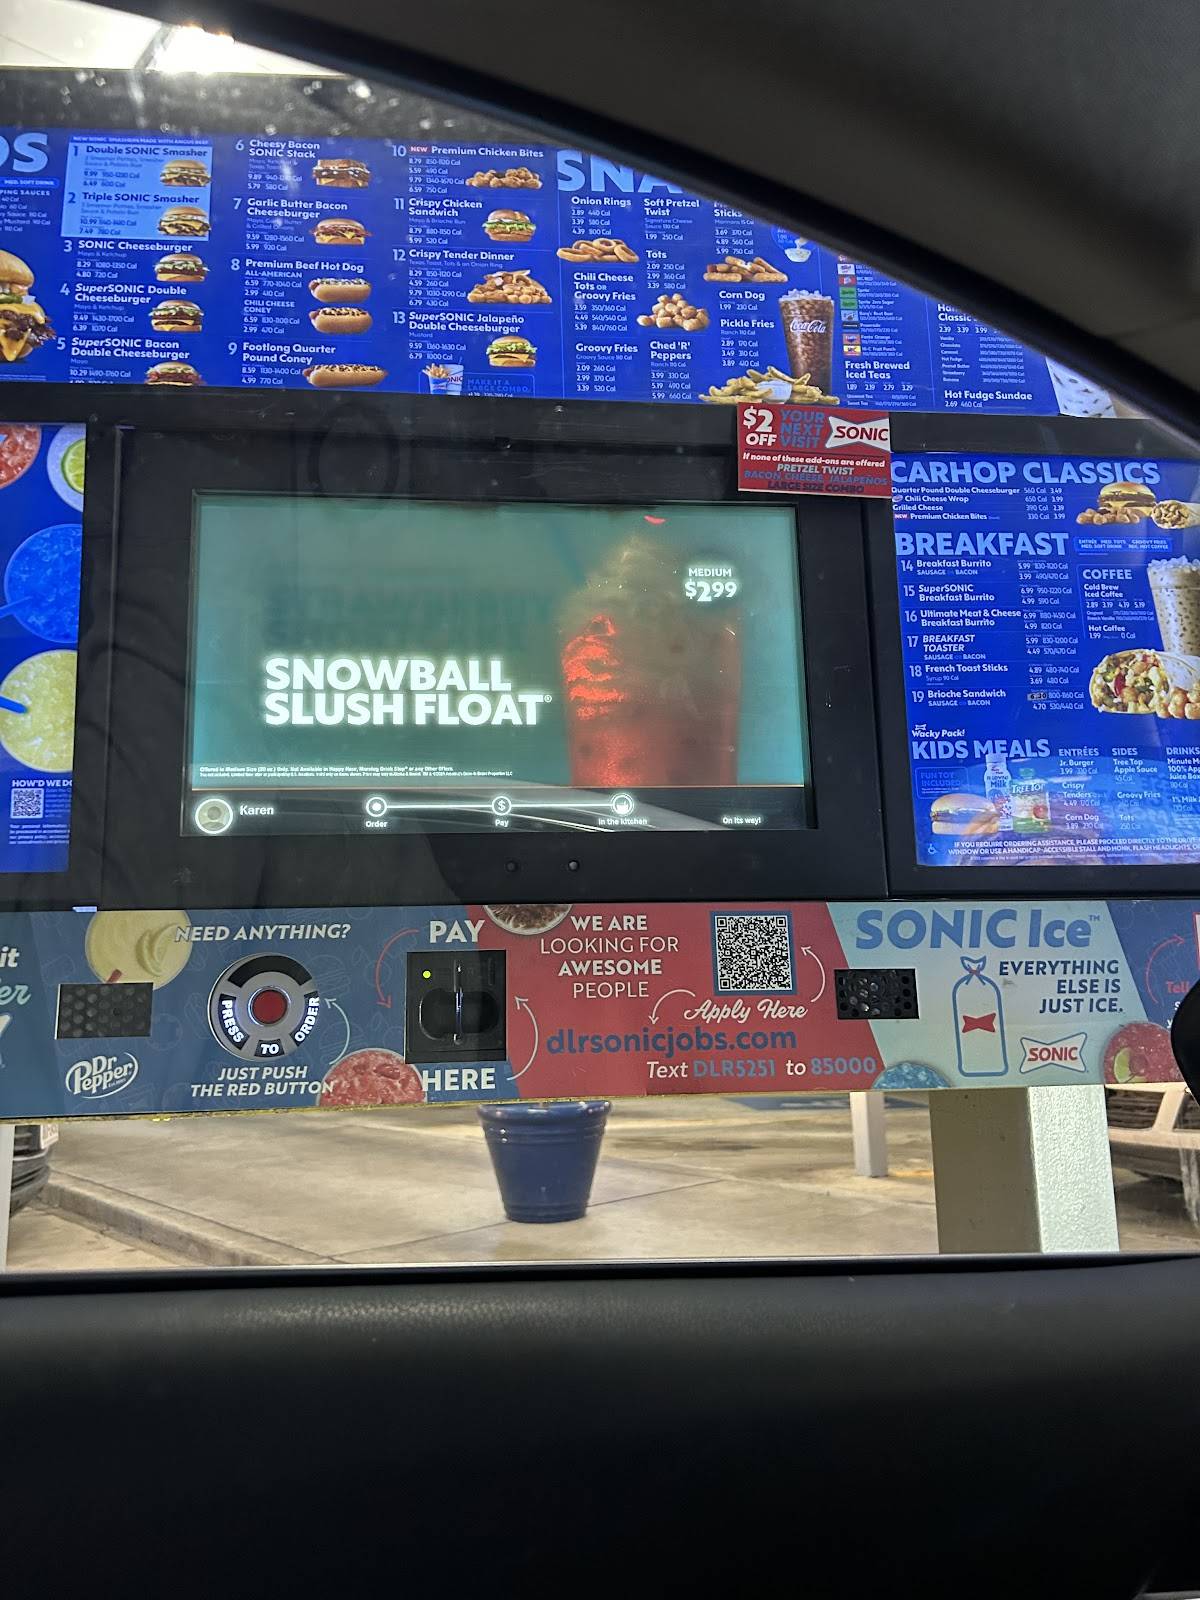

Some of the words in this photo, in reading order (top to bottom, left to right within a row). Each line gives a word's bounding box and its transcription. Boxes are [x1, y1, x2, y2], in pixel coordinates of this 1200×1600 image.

[73, 146, 78, 156] 1
[86, 146, 123, 154] Double
[125, 147, 161, 155] SONIC
[163, 148, 207, 156] Smasher
[235, 140, 244, 150] 6
[250, 140, 286, 149] Cheesy
[288, 141, 320, 149] Bacon
[392, 146, 406, 156] 10
[431, 147, 476, 155] Premium
[478, 148, 517, 156] Chicken
[520, 149, 543, 157] Bites
[0, 132, 48, 172] S
[288, 150, 315, 158] Stack
[572, 197, 602, 205] Onion
[604, 198, 631, 207] Rings
[644, 208, 670, 216] Twist
[64, 241, 72, 252] 3
[79, 241, 114, 249] SONIC
[118, 242, 192, 253] Cheeseburger
[393, 250, 406, 261] 12
[409, 250, 440, 261] Crispy
[443, 251, 478, 259] Tender
[480, 252, 514, 260] Dinner
[231, 259, 240, 270] 8
[246, 259, 293, 269] Premium
[296, 261, 319, 269] Beef
[321, 262, 340, 270] Hot
[343, 263, 363, 273] Dog
[745, 291, 765, 301] Dog
[752, 320, 774, 328] Fries
[576, 343, 612, 354] Groovy
[614, 344, 638, 352] Fries
[650, 341, 675, 349] Ched
[678, 341, 690, 349] 'R'
[651, 351, 691, 361] Peppers
[845, 361, 871, 369] Fresh
[868, 371, 891, 379] Teas
[944, 390, 962, 398] Hot
[964, 391, 994, 401] Fudge
[996, 392, 1032, 400] Sundae
[743, 406, 774, 432] $2
[781, 409, 825, 423] YOUR
[781, 423, 825, 434] NEXT
[834, 426, 888, 441] SONIC
[746, 433, 777, 446] OFF
[781, 435, 821, 448] VISIT
[777, 464, 820, 473] PRETZEL
[822, 466, 854, 475] TWIST
[855, 459, 885, 467] offered
[744, 471, 782, 480] BACON
[784, 473, 823, 482] CHEESE
[891, 461, 1016, 483] CARHOP
[1023, 462, 1161, 484] CLASSICS
[895, 532, 1069, 555] BREAKFAST
[901, 560, 913, 571] 14
[961, 560, 991, 568] Burrito
[688, 568, 731, 577] MEDIUM
[1082, 570, 1132, 579] COFFEE
[265, 658, 512, 691] SNOWBALL
[910, 665, 922, 677] 18
[982, 664, 1008, 672] Sticks
[912, 691, 924, 702] 19
[928, 690, 961, 698] Brioche
[963, 690, 1006, 698] Sandwich
[265, 693, 399, 725] SLUSH
[912, 730, 940, 739] Wacky
[942, 729, 965, 737] Pack!
[912, 741, 968, 759] KIDS
[974, 739, 1050, 758] MEALS
[1059, 746, 1099, 756] ENTRÉES
[1166, 747, 1200, 755] DRINKS
[240, 805, 274, 815] Karen
[745, 817, 761, 825] way!
[570, 916, 603, 931] WE
[608, 915, 648, 931] ARE
[855, 909, 1017, 949] SONIC
[175, 926, 230, 942] NEED
[234, 924, 351, 941] ANYTHING?
[429, 920, 485, 943] PAY
[540, 938, 633, 954] LOOKING
[640, 937, 679, 952] FOR
[558, 959, 662, 977] AWESOME
[999, 960, 1119, 976] EVERYTHING
[573, 982, 649, 998] PEOPLE
[1057, 980, 1099, 994] ELSE
[1104, 979, 1121, 993] IS
[684, 1000, 751, 1023] Apply
[757, 999, 809, 1019] Here
[1039, 999, 1085, 1014] JUST
[1089, 998, 1123, 1013] ICE.
[222, 1000, 244, 1043] PRESS
[261, 1043, 279, 1054] TO
[295, 997, 319, 1042] ORDER
[547, 1027, 797, 1058] dlrsonicjobs.com
[1027, 1047, 1078, 1061] SONIC
[92, 1056, 117, 1075] Dr
[647, 1060, 689, 1079] Text
[693, 1059, 776, 1077] DLR5251
[786, 1059, 806, 1075] to
[811, 1057, 876, 1075] 85000
[74, 1061, 133, 1094] Pepper
[218, 1067, 259, 1081] JUST
[262, 1066, 308, 1079] PUSH
[422, 1068, 496, 1092] HERE
[191, 1084, 224, 1097] THE
[227, 1083, 261, 1095] RED
[264, 1081, 334, 1094] BUTTON
